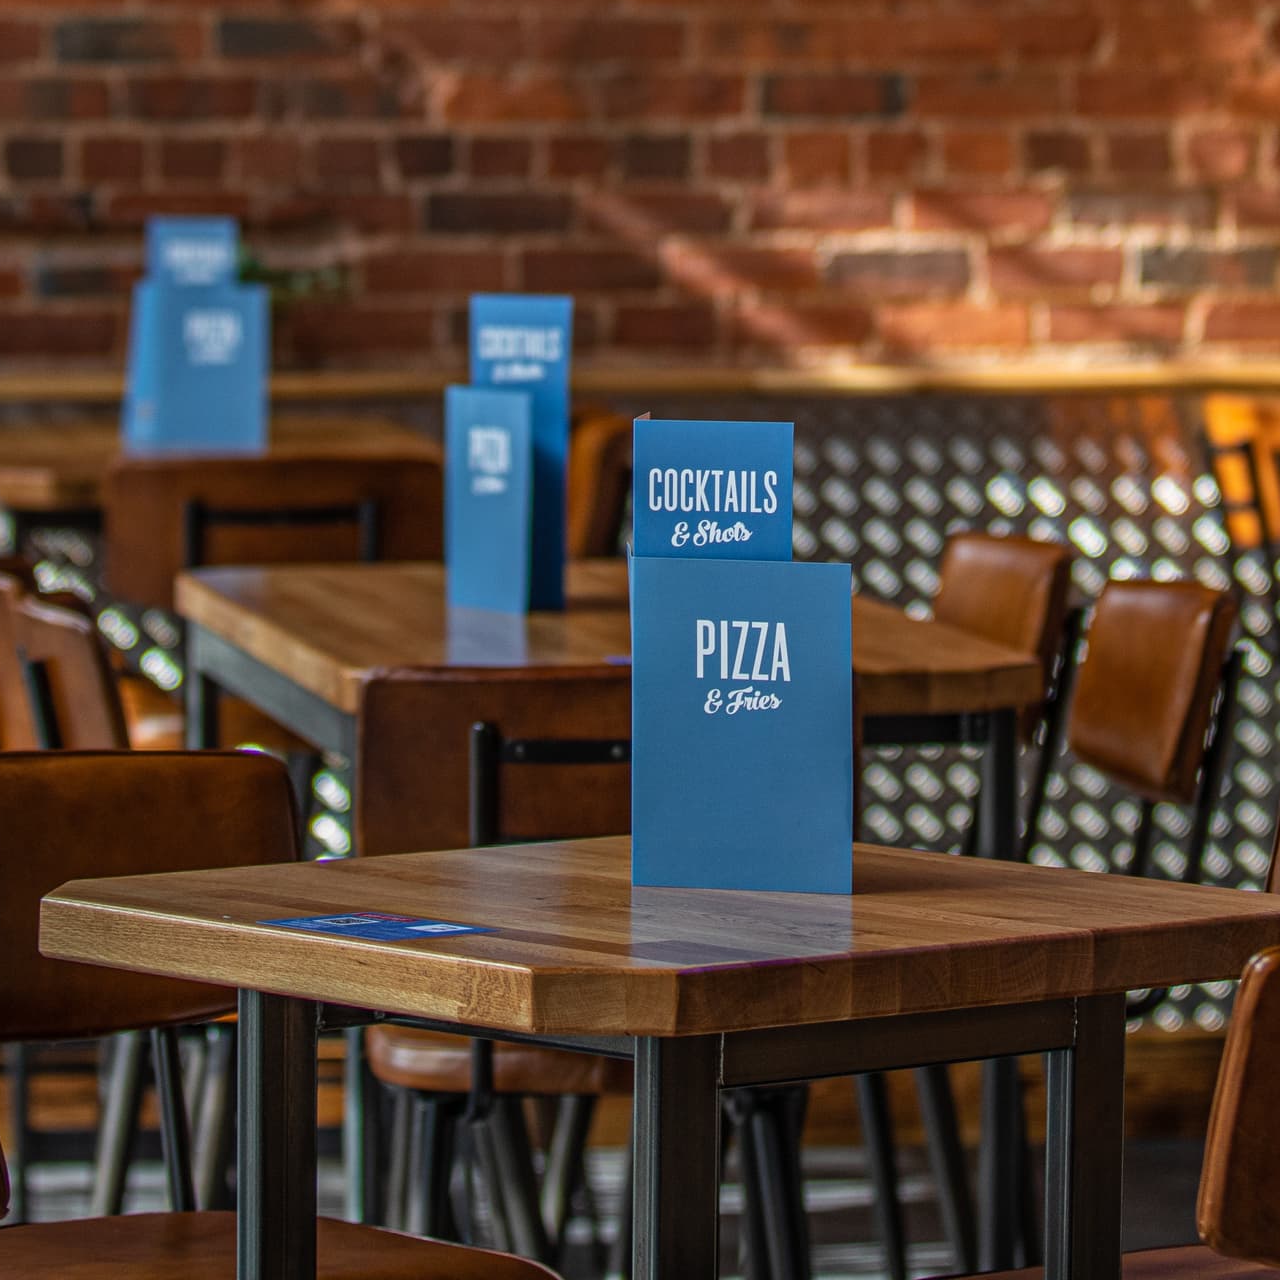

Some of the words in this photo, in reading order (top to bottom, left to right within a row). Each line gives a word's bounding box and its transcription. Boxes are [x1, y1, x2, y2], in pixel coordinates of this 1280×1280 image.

[648, 467, 779, 515] COCKTAILS
[670, 521, 691, 548] &
[693, 519, 753, 547] Shots
[695, 619, 792, 682] PIZZA
[703, 688, 723, 714] &
[725, 685, 783, 715] Fries
